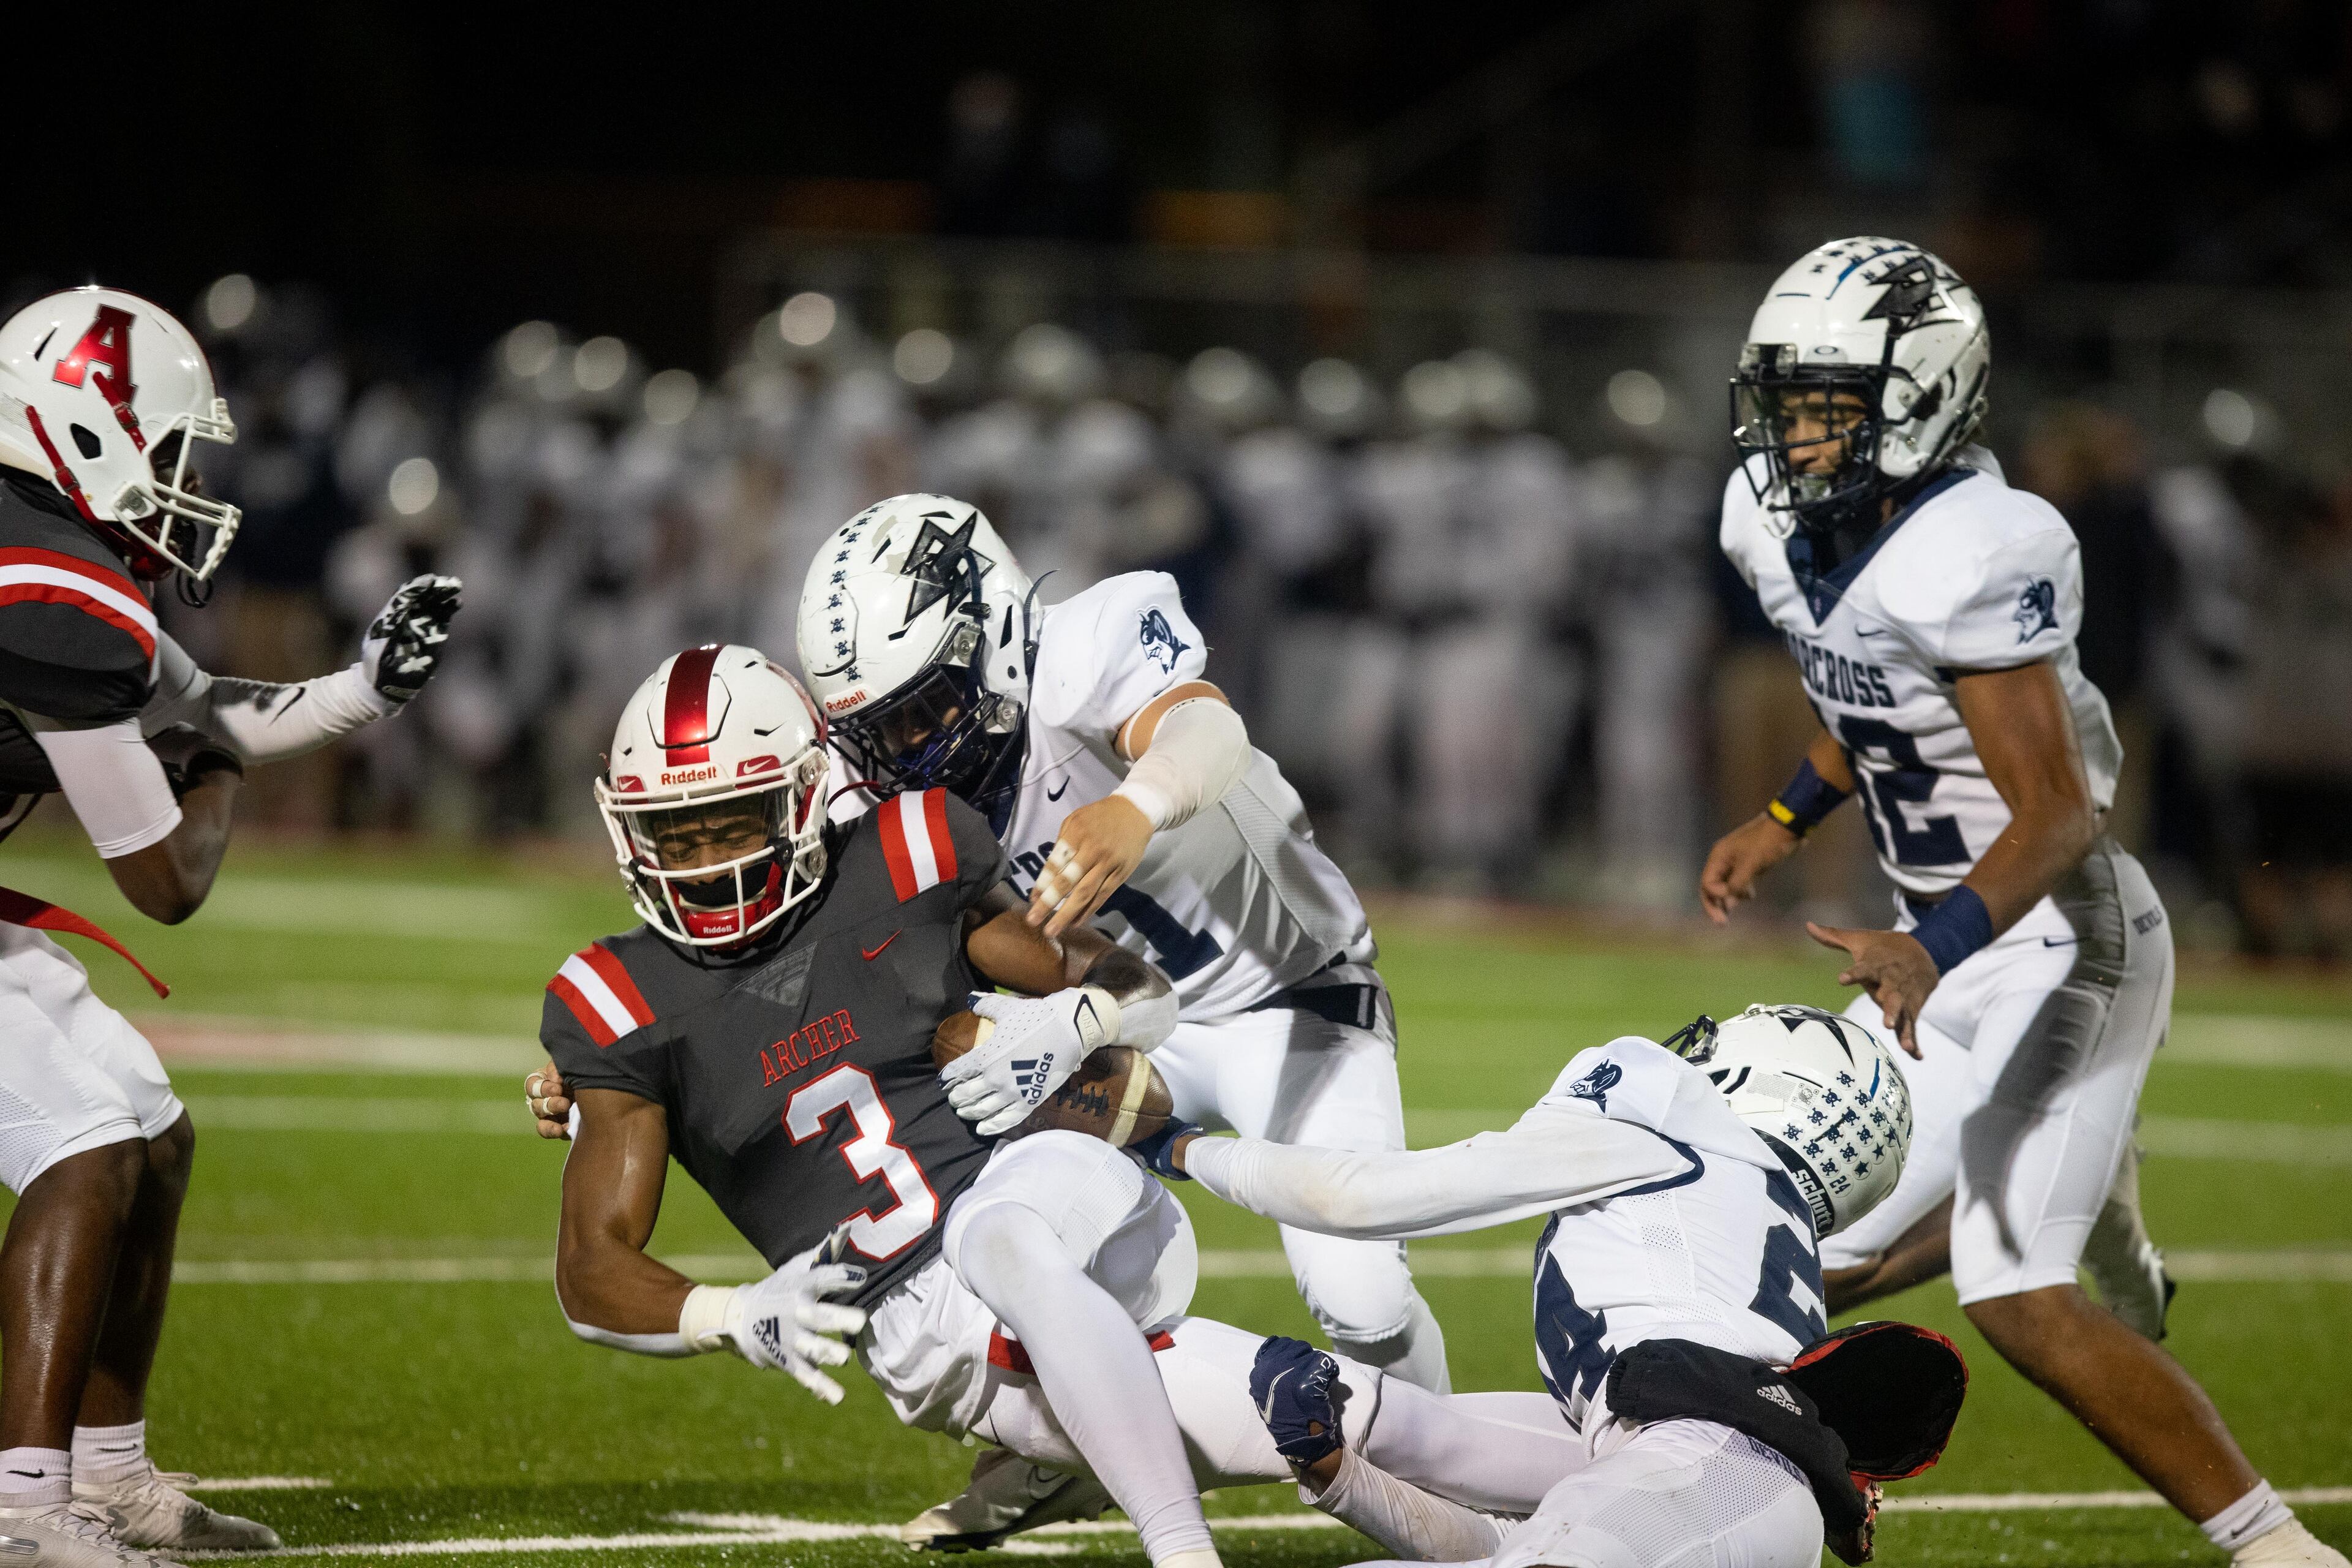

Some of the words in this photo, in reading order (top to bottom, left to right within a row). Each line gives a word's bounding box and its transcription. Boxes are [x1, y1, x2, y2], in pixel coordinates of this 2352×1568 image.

[53, 303, 138, 409] A
[826, 690, 867, 712] Riddell
[661, 766, 717, 785] Riddell
[759, 1009, 861, 1087] ARCHER
[1027, 1052, 1054, 1105] adidas
[781, 1061, 940, 1262] 3
[1830, 1175, 1851, 1194] 24
[1792, 1169, 1833, 1229] schutt
[1757, 1389, 1802, 1415] adidas
